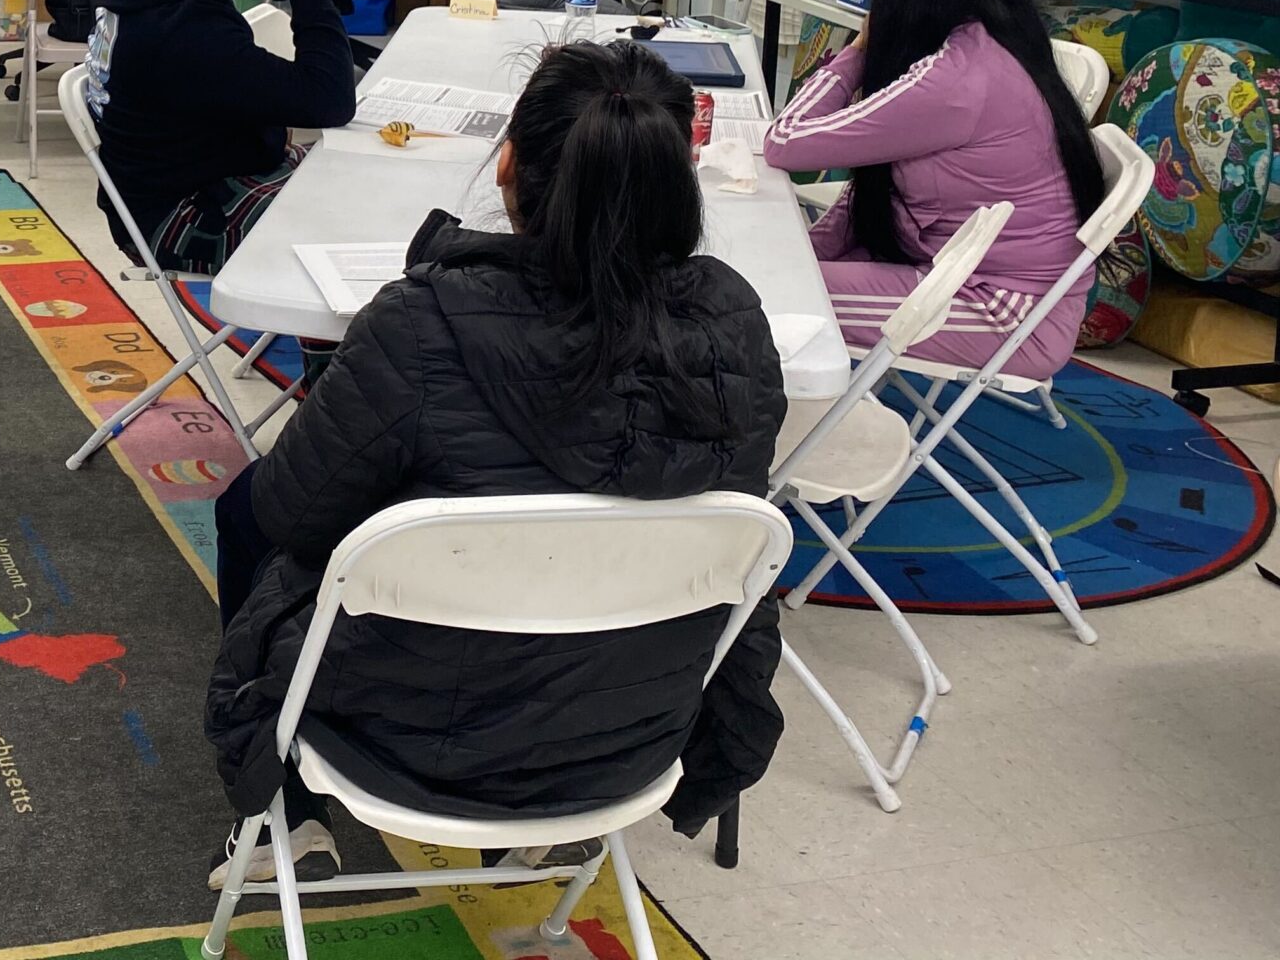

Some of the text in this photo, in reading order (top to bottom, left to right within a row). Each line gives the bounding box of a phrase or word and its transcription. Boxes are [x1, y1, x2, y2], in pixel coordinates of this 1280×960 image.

[8, 216, 39, 232] Bb
[55, 268, 89, 286] Cc
[104, 332, 154, 354] Dd
[170, 410, 214, 435] Ee
[264, 913, 441, 952] ice-crem
